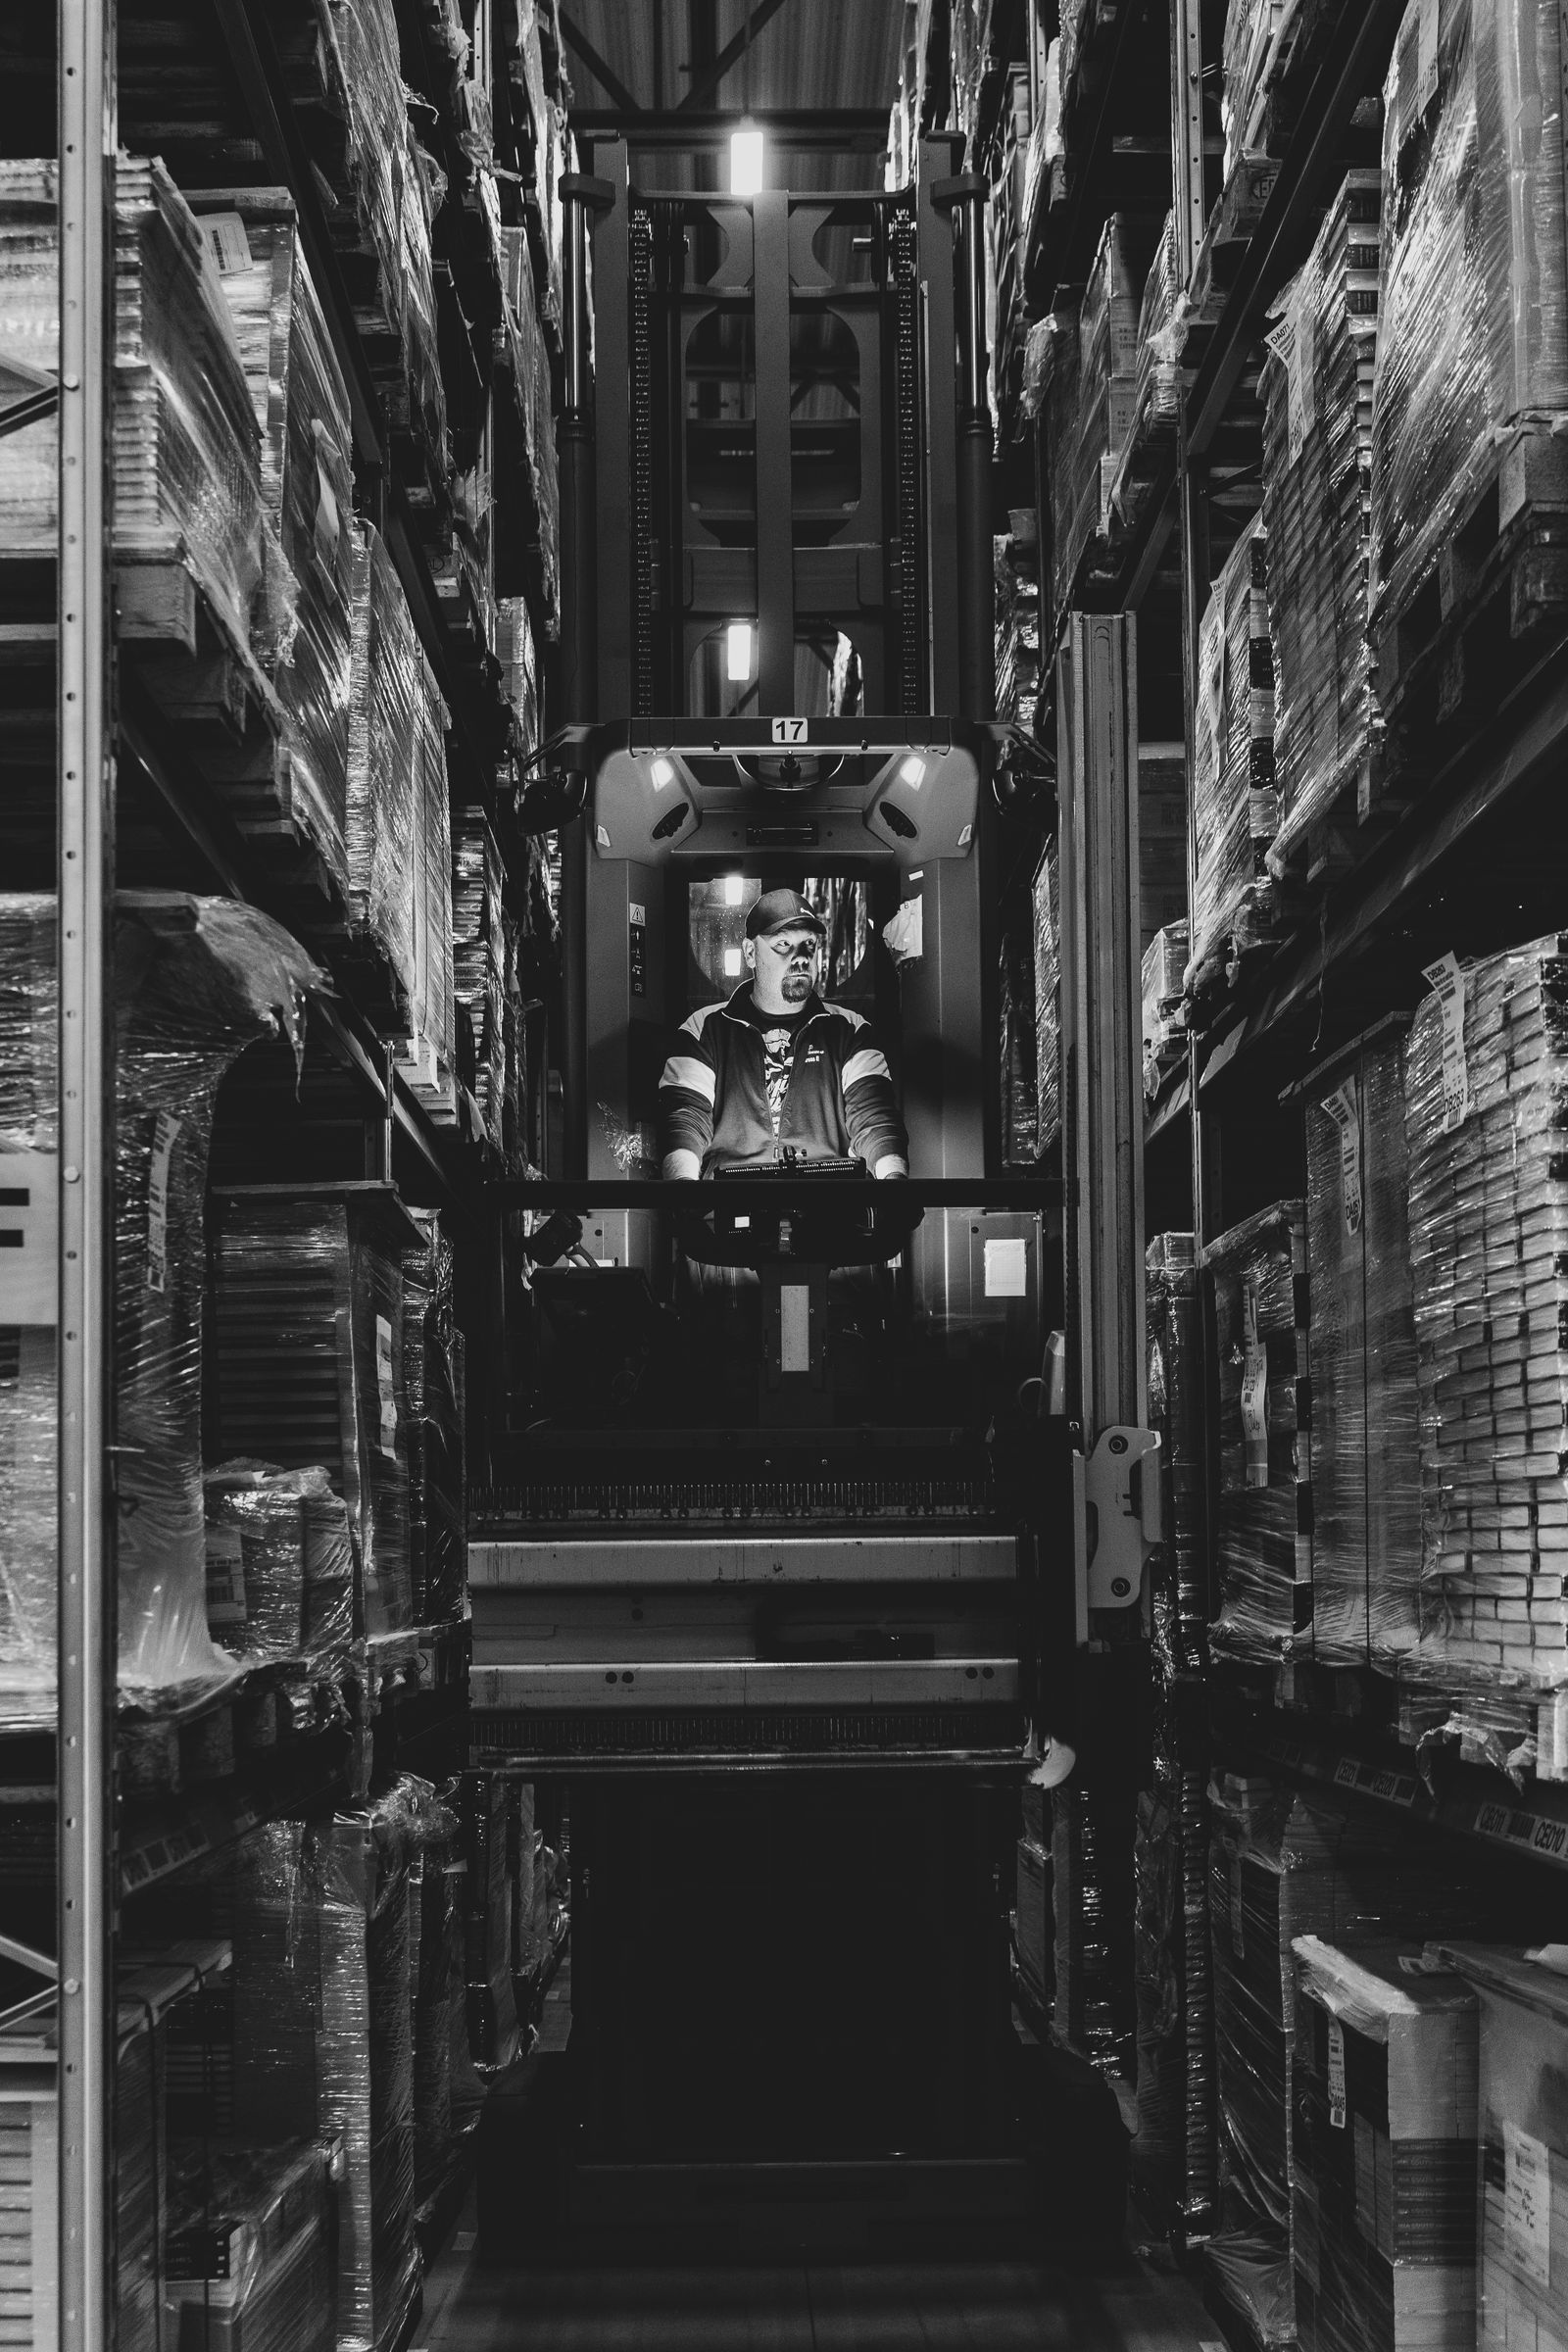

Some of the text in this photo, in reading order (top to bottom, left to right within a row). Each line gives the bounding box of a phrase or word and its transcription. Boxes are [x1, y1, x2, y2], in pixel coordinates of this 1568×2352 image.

[1270, 322, 1291, 345] DA071
[775, 720, 804, 740] 17
[1444, 1088, 1464, 1114] DB263
[1480, 1805, 1506, 1834] CE011
[1535, 1821, 1566, 1853] CE010
